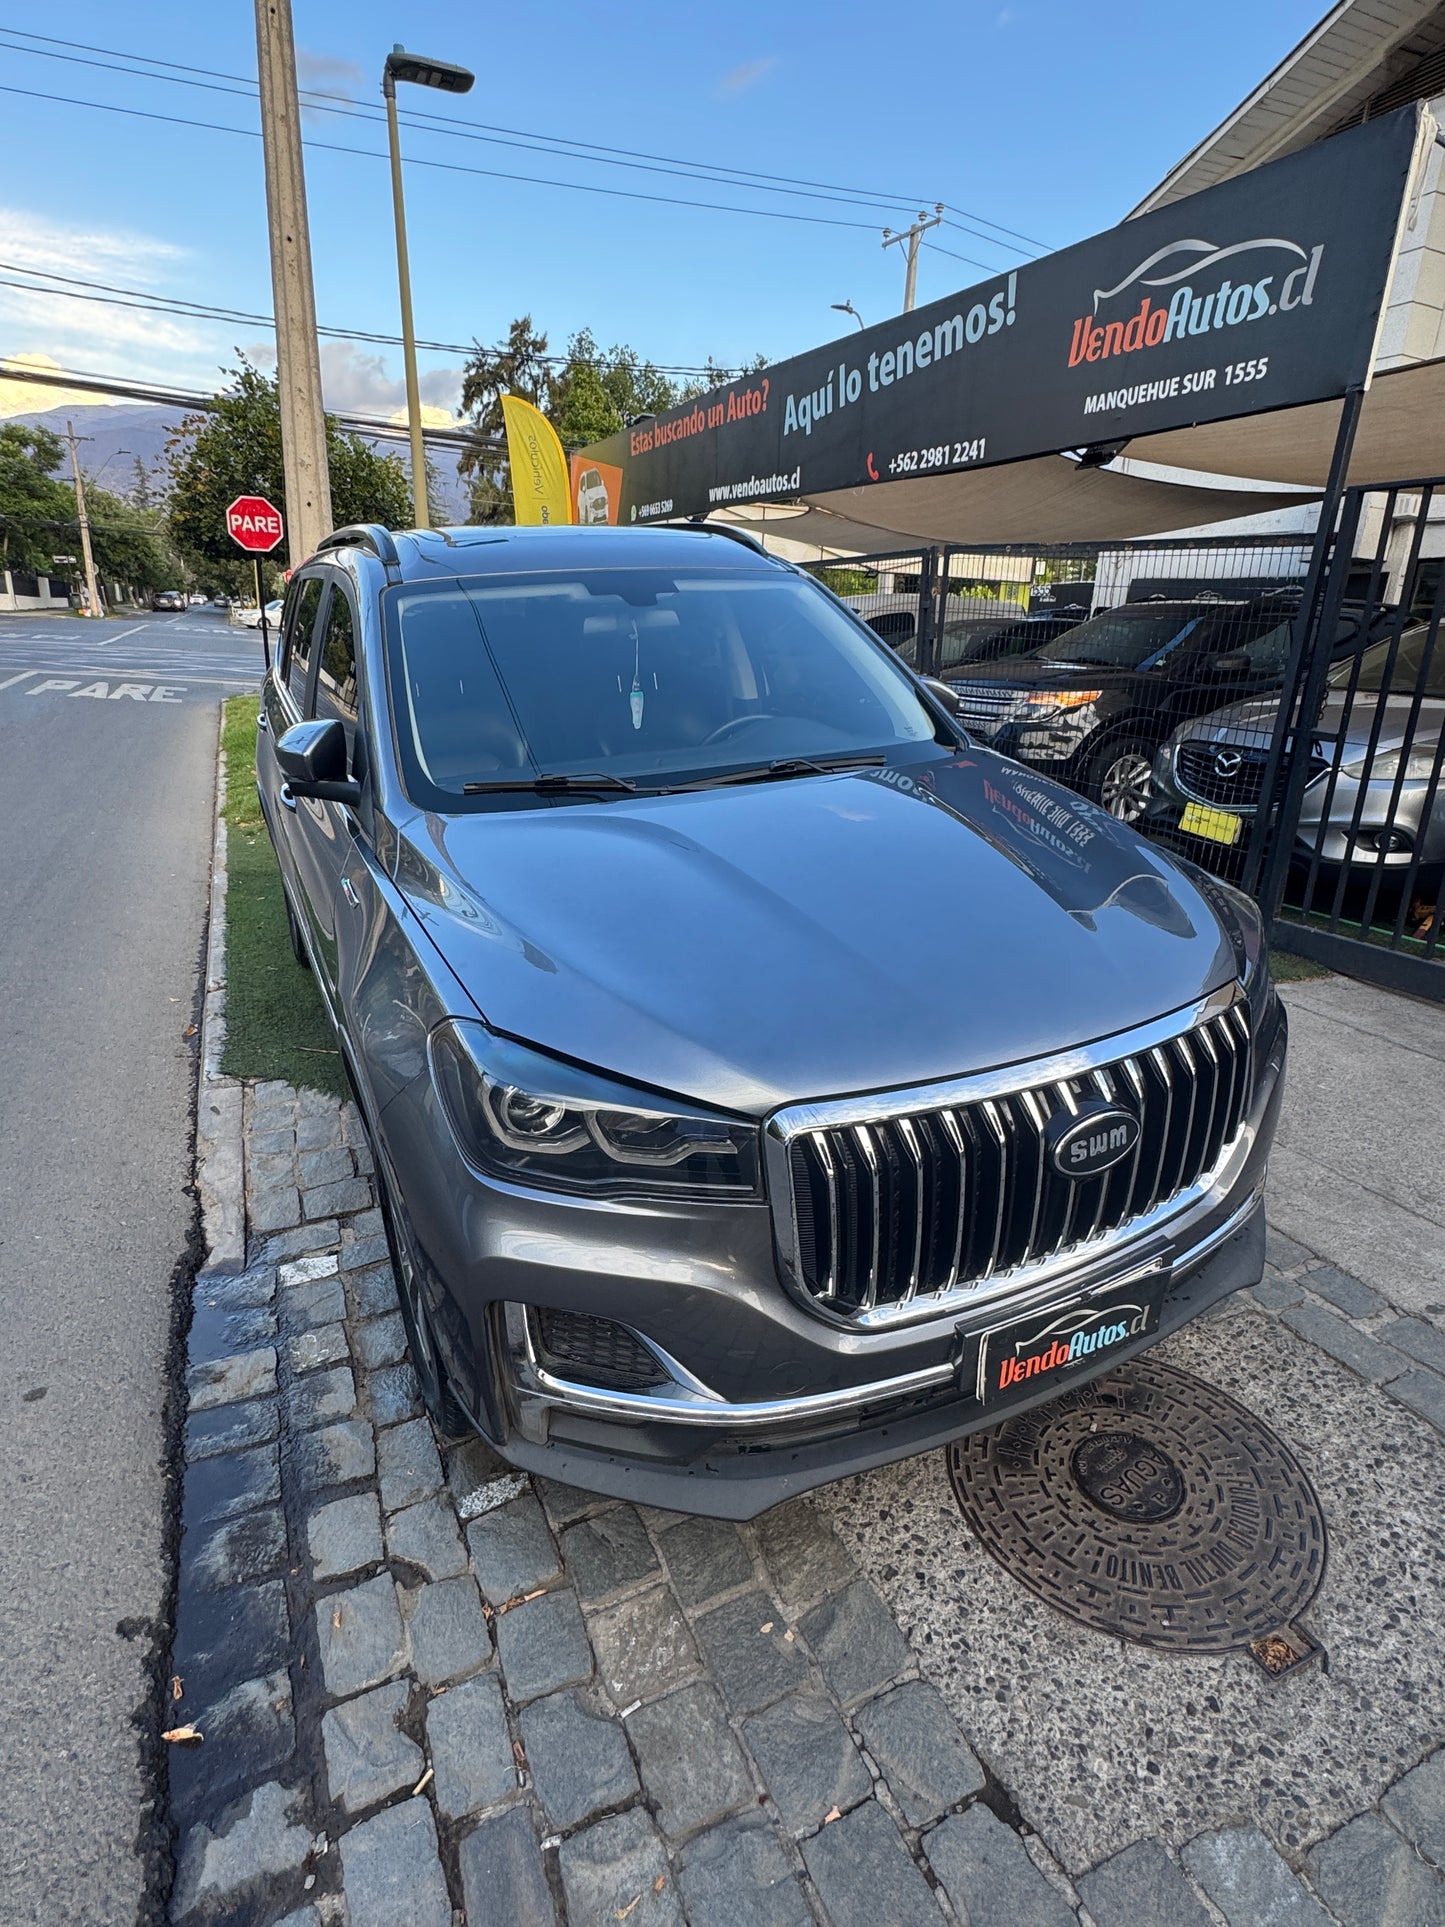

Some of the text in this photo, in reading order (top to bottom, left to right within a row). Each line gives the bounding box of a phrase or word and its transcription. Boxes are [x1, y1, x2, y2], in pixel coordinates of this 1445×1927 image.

[1067, 244, 1325, 368] VendoAutos.cl
[783, 270, 1018, 437] Aquí lo tenemos!
[1084, 357, 1269, 415] MANQUEHUE SUR 1555
[630, 378, 770, 457] Estas buscando un Auto?
[888, 438, 986, 474] +562 2981 2241
[708, 466, 801, 502] www.vendoautos.cl
[231, 514, 280, 534] PARE
[25, 679, 189, 704] PARE
[1070, 1124, 1128, 1164] SWM
[999, 1304, 1150, 1390] VendoAutos.cl
[1100, 1454, 1168, 1506] AGUAS
[1106, 1554, 1185, 1592] BENITO
[1179, 1540, 1246, 1587] DUCTIL
